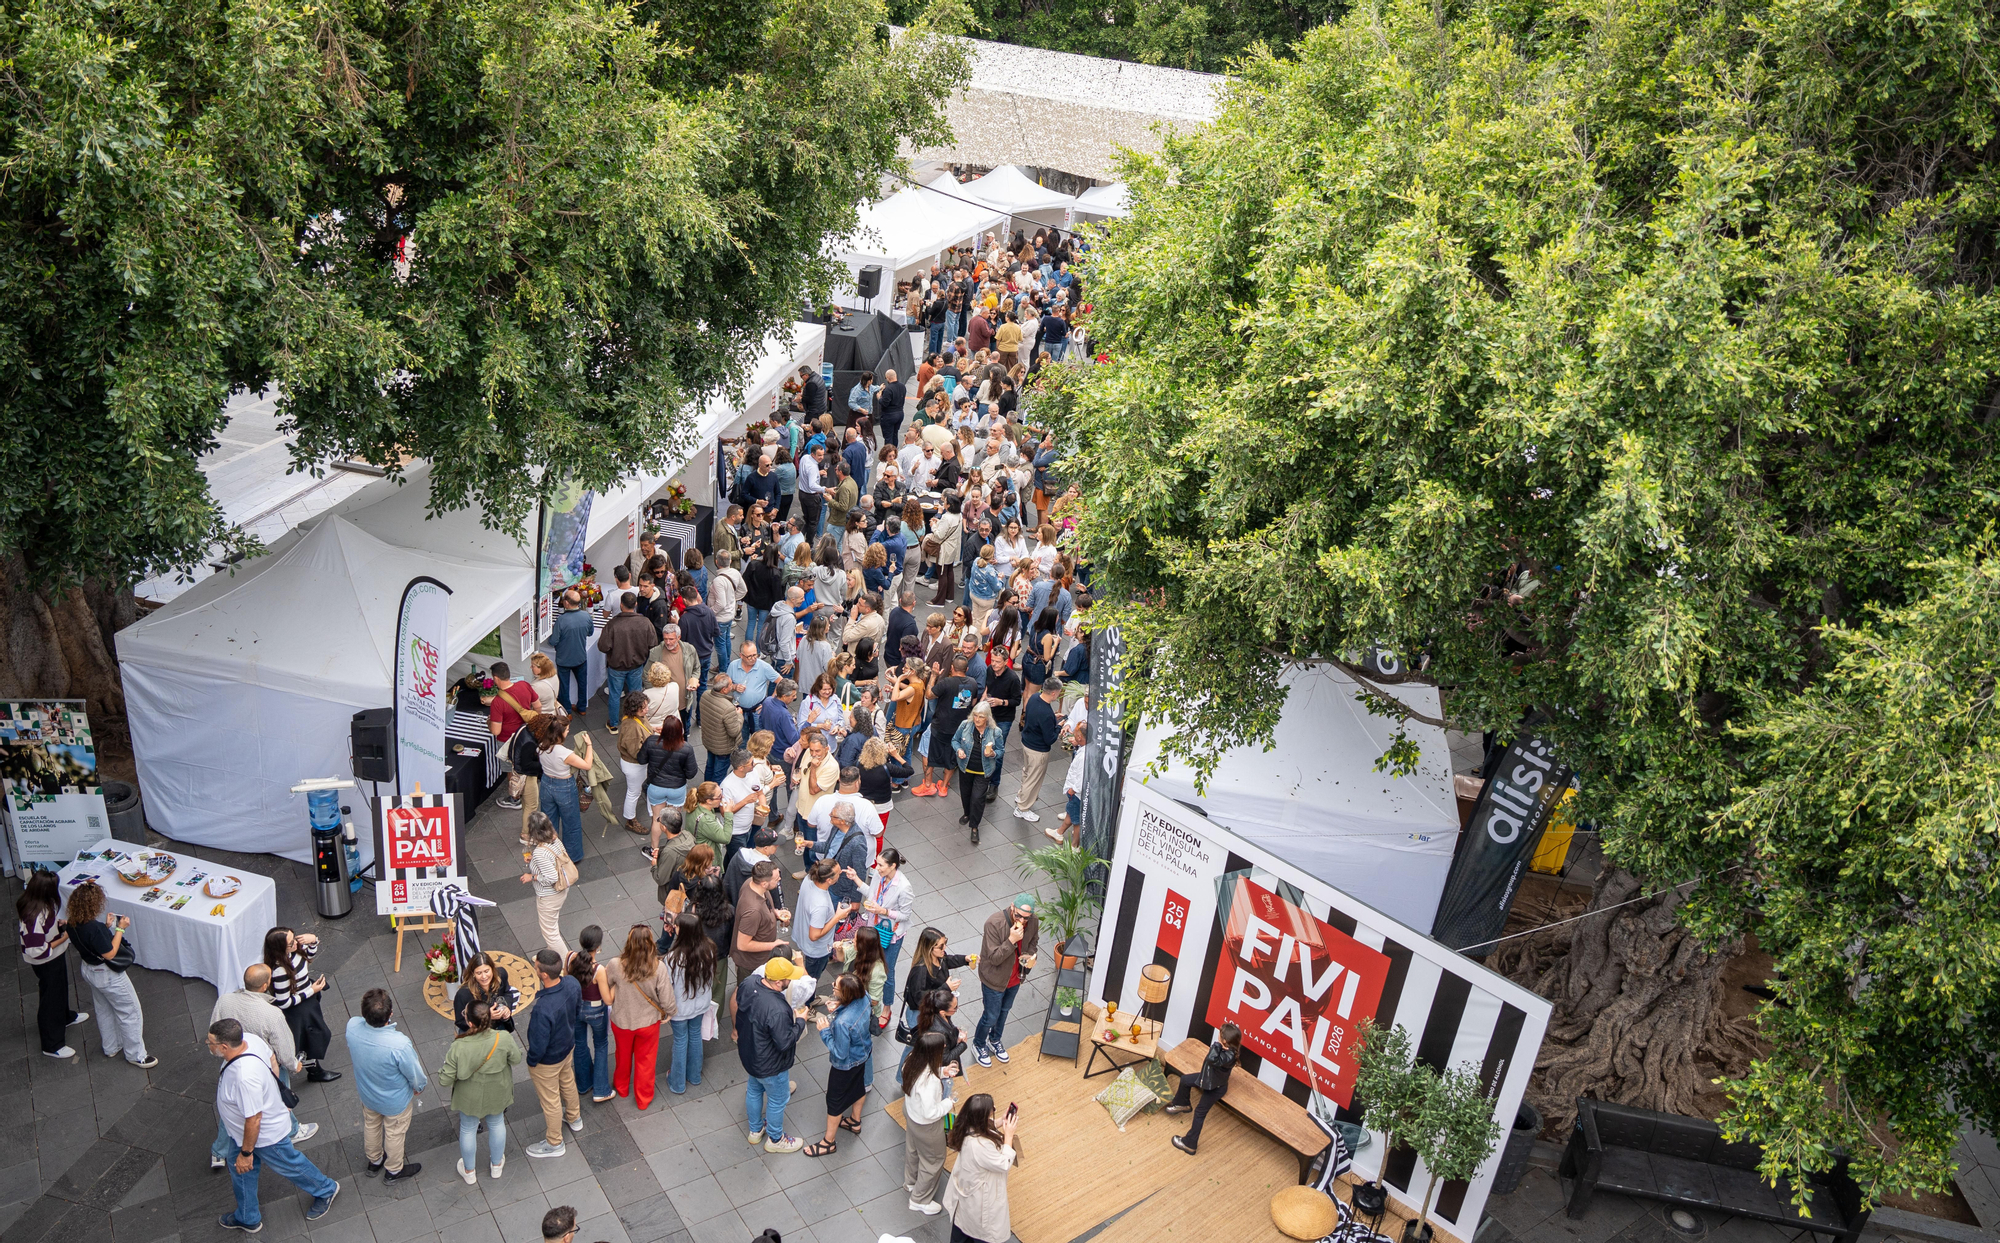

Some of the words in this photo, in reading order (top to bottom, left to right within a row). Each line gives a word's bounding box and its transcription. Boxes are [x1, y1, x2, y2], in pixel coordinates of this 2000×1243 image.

[399, 585, 437, 686] www.vinoslapalma.com
[1527, 780, 1558, 831] TROPICAL
[394, 817, 442, 838] FIVI
[1140, 828, 1157, 845] DEL
[1159, 839, 1183, 858] VINO
[1141, 819, 1167, 840] FERIA
[1169, 834, 1210, 864] INSULAR
[1143, 809, 1158, 823] XV
[1159, 818, 1202, 849] EDICIÓN
[396, 839, 445, 859] PAL
[1137, 838, 1151, 852] DE
[1152, 846, 1164, 859] LA
[1165, 853, 1198, 878] PALMA
[394, 883, 404, 891] 25
[1498, 860, 1522, 911] alisiosgroup.com
[1164, 912, 1182, 930] 04
[1167, 900, 1185, 918] 25
[1239, 912, 1361, 1021] FIVI
[1227, 966, 1341, 1076] PAL
[1327, 1025, 1345, 1056] 2026
[1243, 1029, 1278, 1053] LLANOS
[1281, 1052, 1293, 1062] DE
[1296, 1062, 1336, 1090] ARIDANE
[1494, 1059, 1505, 1080] ALCOHOL
